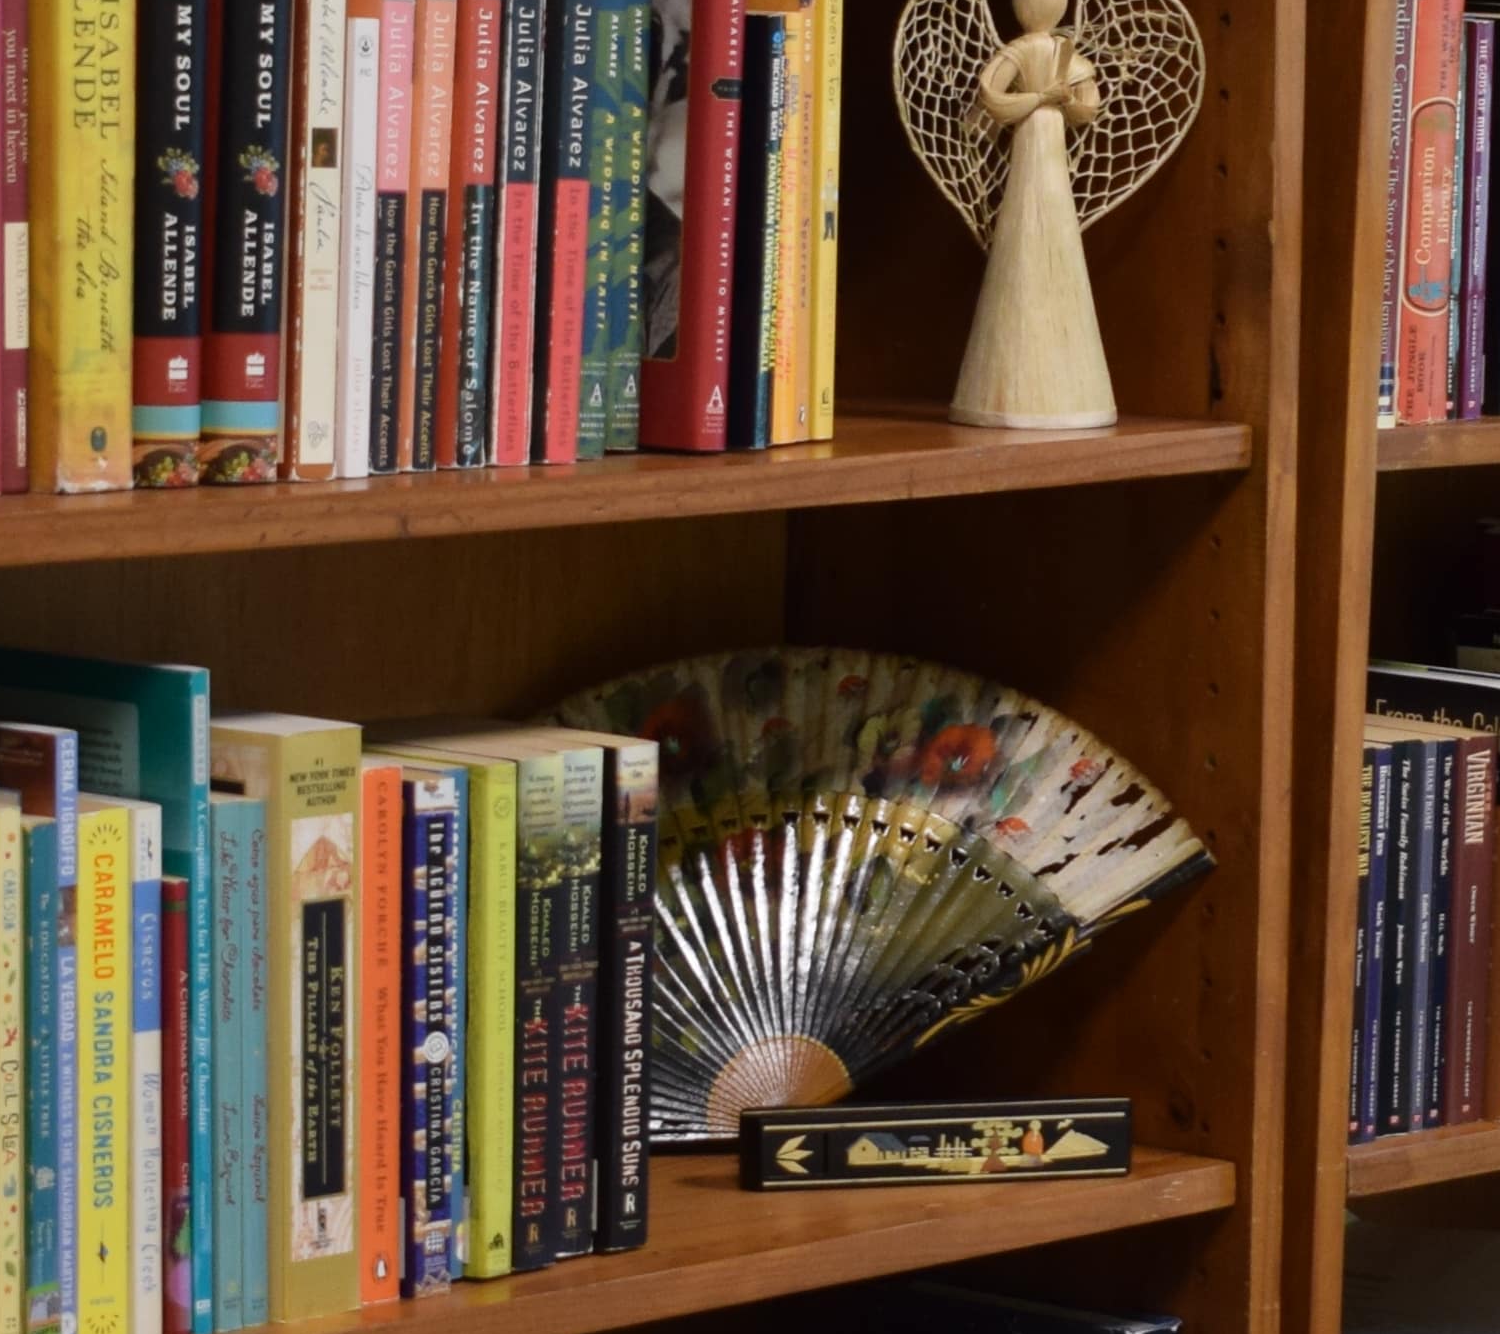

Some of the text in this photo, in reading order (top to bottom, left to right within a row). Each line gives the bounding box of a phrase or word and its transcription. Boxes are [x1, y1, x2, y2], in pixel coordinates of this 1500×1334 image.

[176, 4, 192, 46] MY
[260, 4, 275, 44] MY
[174, 56, 191, 131] SOUL
[255, 54, 273, 129] SOUL
[384, 11, 408, 180] Julia Alvarez
[427, 11, 451, 179] Julia Alvarez
[473, 8, 493, 174] Julia Alvarez
[513, 6, 535, 171] Julia Alvarez
[568, 4, 592, 168] Julia Alvarez
[470, 233, 482, 268] the
[471, 202, 483, 224] In
[716, 112, 734, 362] THE WOMAN KEPT TO MYSELF
[162, 213, 178, 320] ALLENDE
[183, 225, 196, 309] ISABEL
[241, 209, 259, 317] ALLENDE
[261, 222, 275, 305] ISABEL
[465, 346, 477, 368] of
[60, 738, 76, 793] CERNA
[1465, 749, 1490, 845] VIRGINIAN
[375, 781, 388, 875] CAROLYN
[570, 879, 580, 953] HOSSEINI
[582, 885, 591, 944] KHALED
[427, 946, 444, 1023] SISTERS
[624, 954, 644, 1045] THOUSAND
[92, 853, 116, 1209] CARAMELO SANDRA CISNEROS
[305, 937, 320, 1164] THE PILLARS EARTH
[329, 967, 343, 1127] KEN FOLLETT
[563, 1004, 589, 1070] KITE
[427, 1067, 442, 1142] CRISTINA
[520, 1018, 549, 1218] KITE RUNNER
[622, 1049, 642, 1137] SPLENDID
[560, 1078, 587, 1201] RUNNER
[622, 1139, 641, 1187] SUNS
